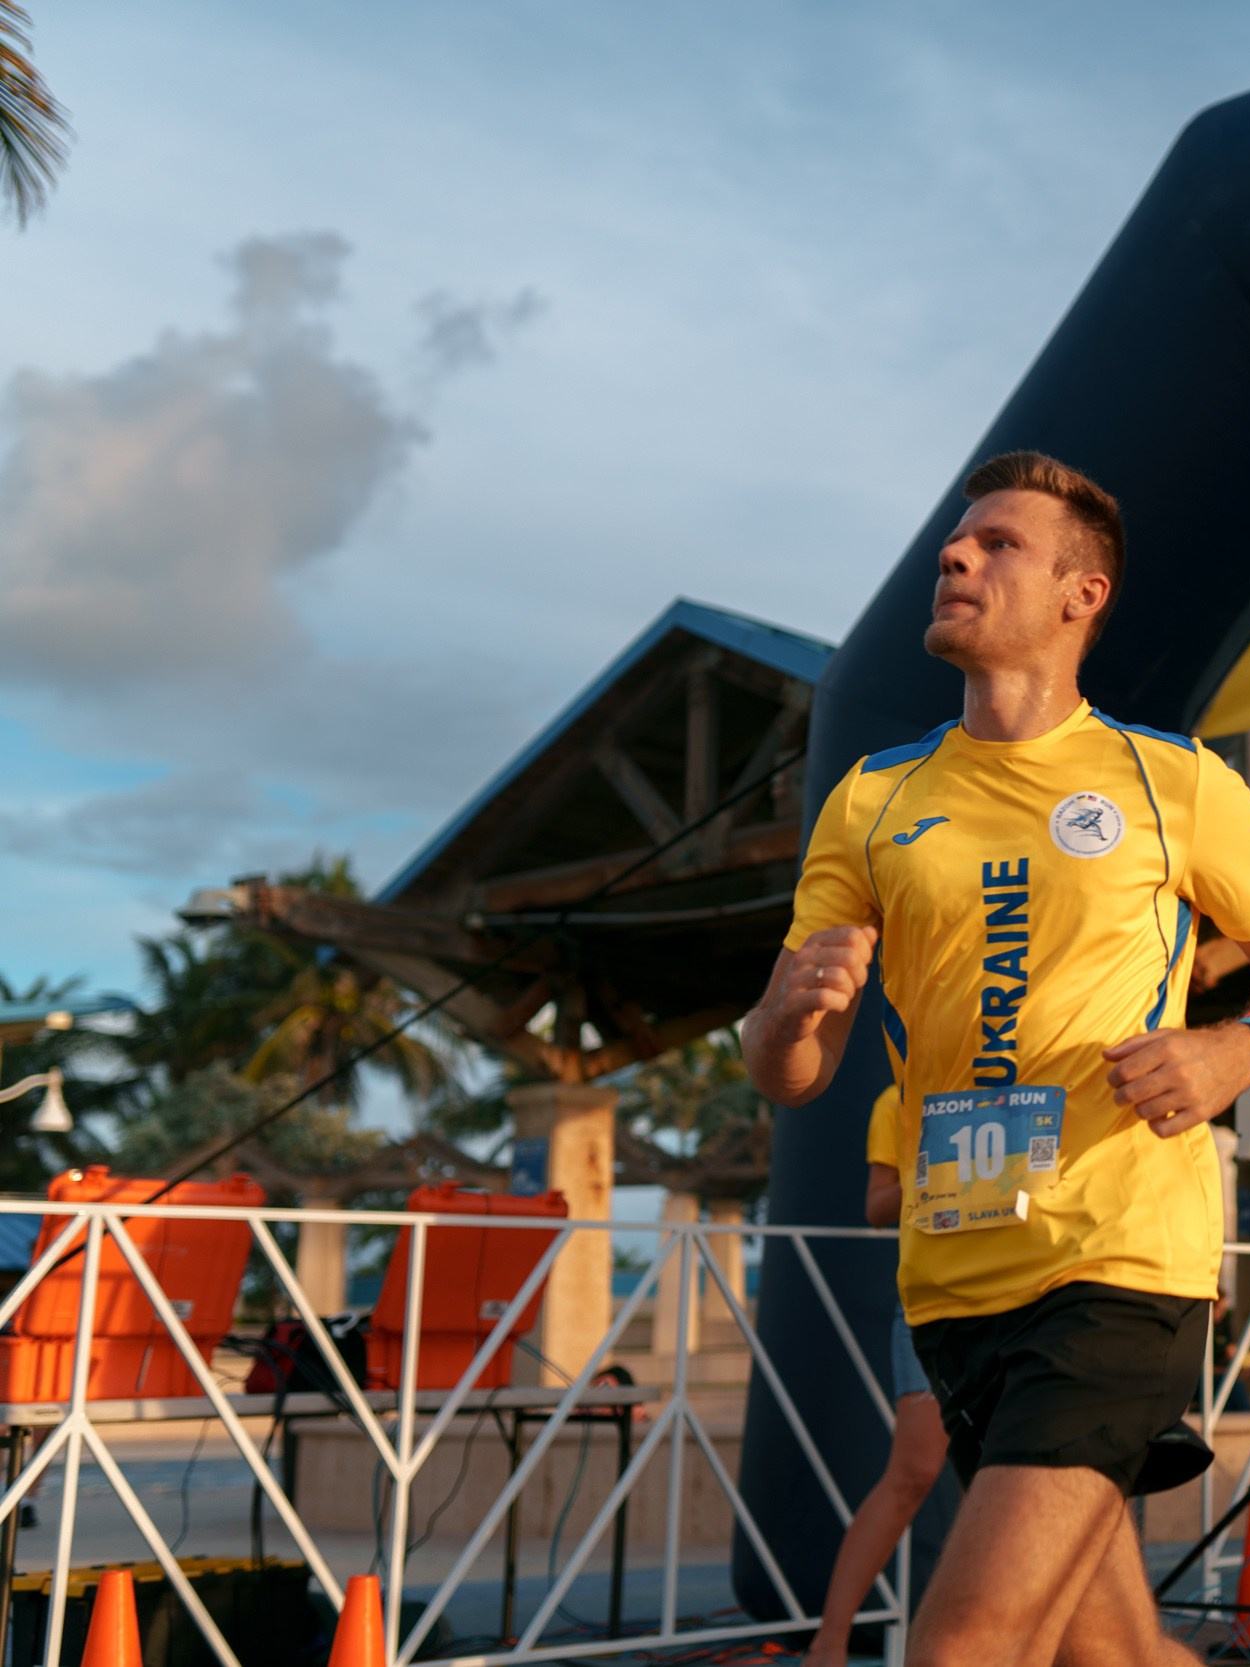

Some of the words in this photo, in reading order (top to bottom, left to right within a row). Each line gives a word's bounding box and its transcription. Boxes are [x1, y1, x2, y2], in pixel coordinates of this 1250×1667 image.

[972, 857, 1029, 1088] UKRAINE
[1009, 1092, 1047, 1107] RUN
[1035, 1115, 1053, 1126] 5K
[949, 1121, 1006, 1183] 10
[968, 1208, 999, 1221] SLAVA
